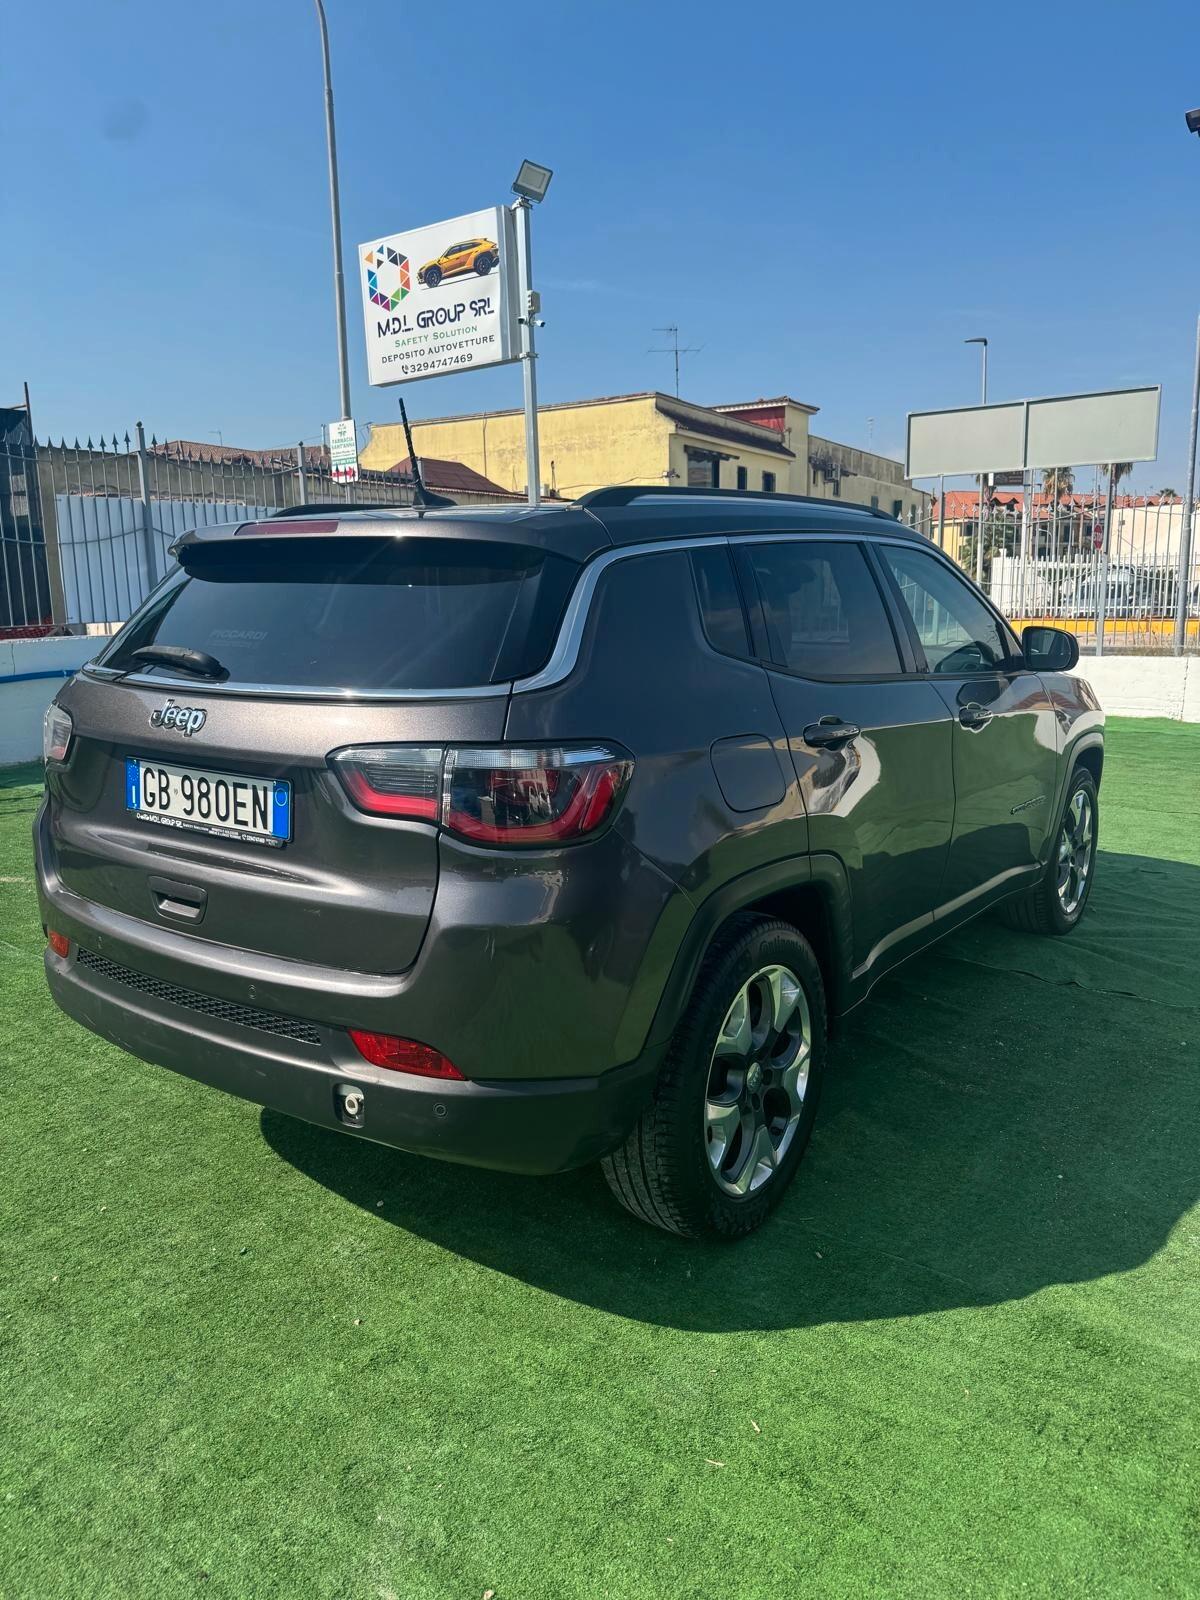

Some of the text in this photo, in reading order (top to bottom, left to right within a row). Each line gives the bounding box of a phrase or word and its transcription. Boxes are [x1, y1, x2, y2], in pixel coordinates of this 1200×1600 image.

[416, 303, 465, 330] GROUP
[469, 297, 495, 317] SRL
[381, 334, 495, 364] DEPOSITO AUTOVETTURE
[410, 353, 473, 373] 3294747469
[149, 699, 208, 737] Jeep
[143, 767, 268, 830] GB 980EN
